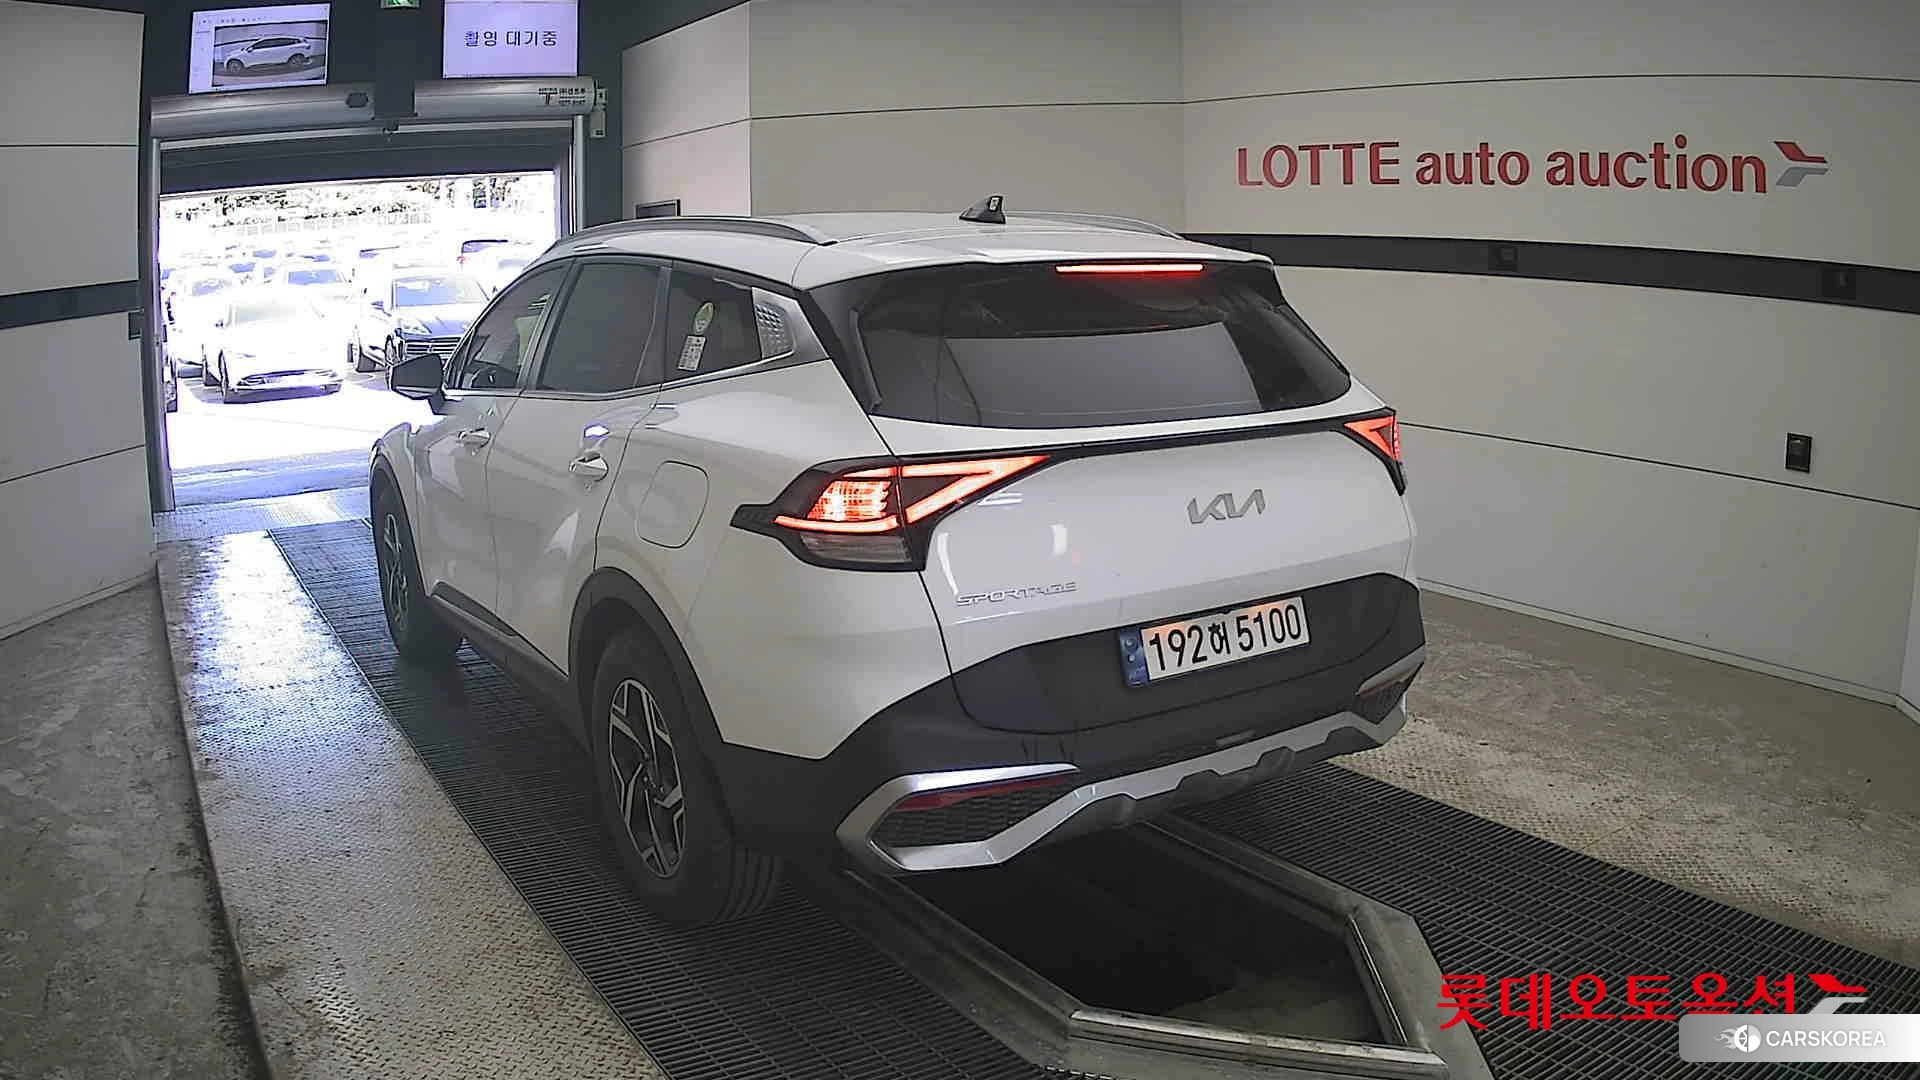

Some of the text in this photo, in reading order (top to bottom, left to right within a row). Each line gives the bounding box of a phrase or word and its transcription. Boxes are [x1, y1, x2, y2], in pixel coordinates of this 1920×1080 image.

[505, 30, 557, 47] 대기중
[1236, 134, 1767, 194] LOTTE auto auction
[1187, 488, 1266, 524] KIA
[956, 581, 1078, 606] SPORTAGE
[1235, 604, 1302, 651] 5100
